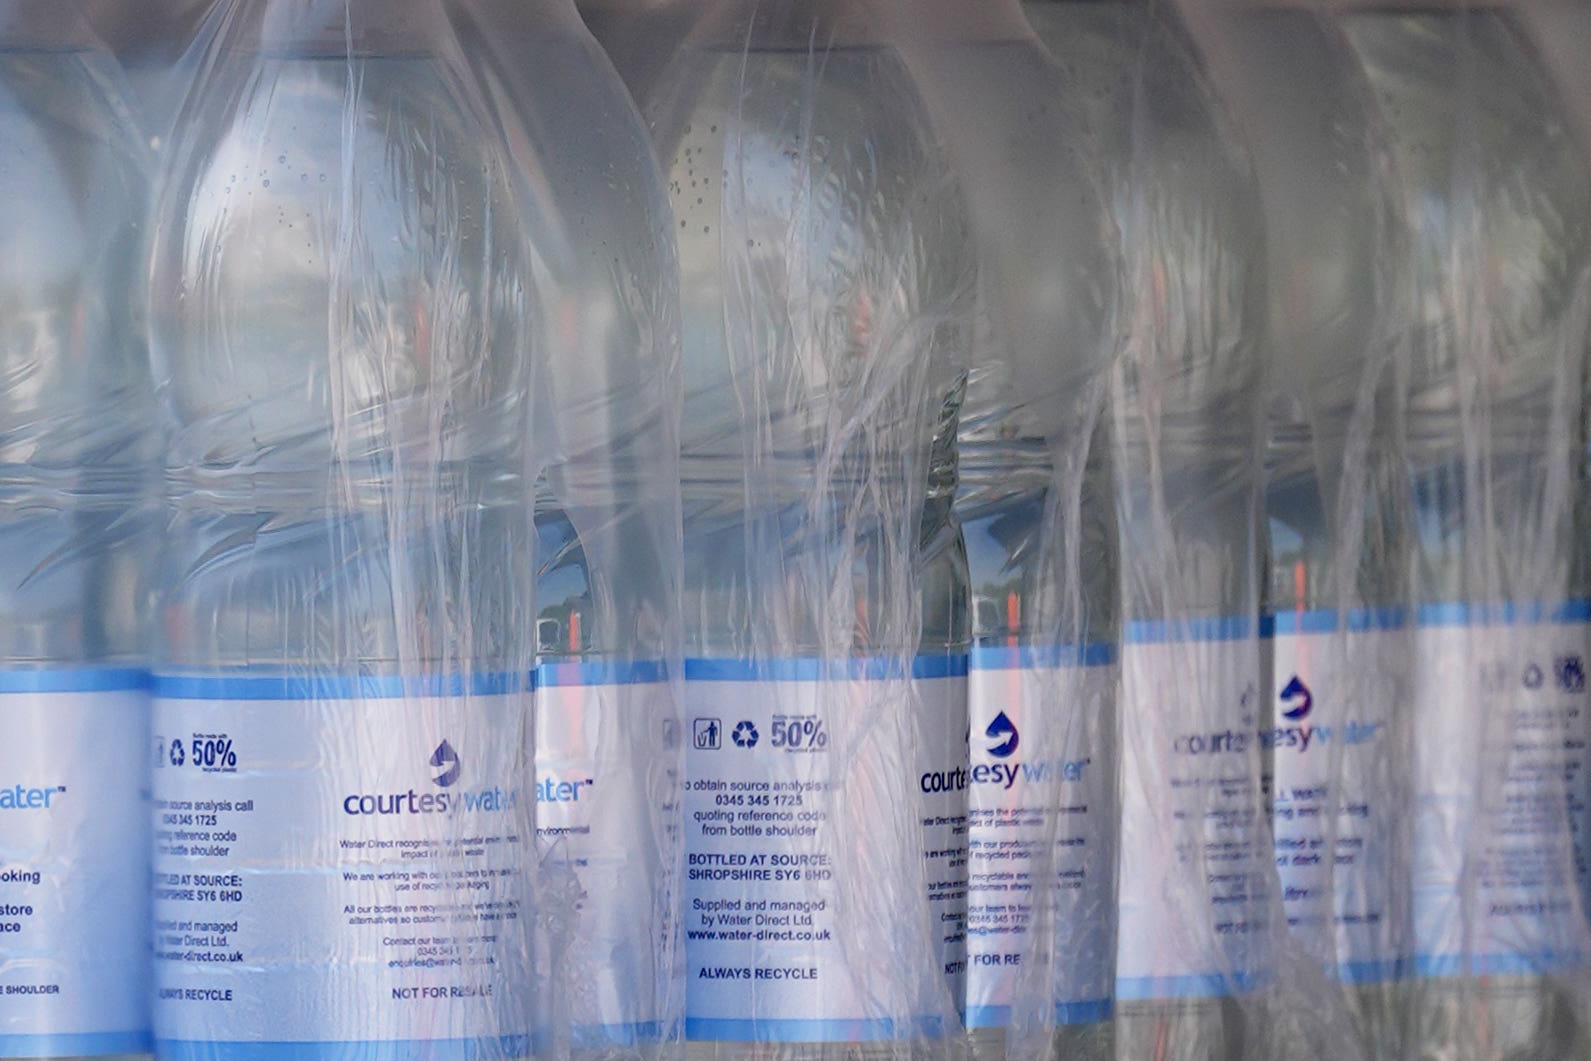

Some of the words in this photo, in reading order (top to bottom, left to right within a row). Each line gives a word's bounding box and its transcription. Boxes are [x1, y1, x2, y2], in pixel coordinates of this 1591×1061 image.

[771, 719, 827, 748] 50%
[193, 738, 237, 767] 50%
[693, 780, 727, 792] obtain
[729, 781, 770, 792] source
[195, 800, 233, 813] analysis
[235, 800, 254, 811] call
[716, 794, 744, 806] 0345
[747, 794, 770, 806] 345
[774, 794, 803, 806] 1725
[196, 815, 218, 826] 1725
[693, 811, 735, 824] quoting
[738, 810, 794, 823] reference
[212, 830, 237, 842] code
[702, 824, 728, 836] from
[730, 824, 763, 837] bottle
[766, 825, 817, 837] shoulder
[191, 845, 230, 856] shoulder
[688, 853, 747, 866] BOTTLED
[749, 854, 768, 866] AT
[194, 875, 243, 887] SOURCE:
[688, 868, 772, 881] SHROPSHIRE
[775, 869, 801, 881] SY6
[197, 890, 217, 902] SY6
[220, 890, 243, 902] 6HD
[693, 898, 742, 912] Supplied
[745, 900, 767, 912] and
[770, 900, 826, 915] managed
[702, 913, 715, 928] by
[717, 914, 753, 926] Water
[756, 914, 790, 926] Direct
[194, 921, 238, 935] managed
[687, 929, 831, 942] www.water-direct.co.uk
[698, 968, 752, 980] ALWAYS
[755, 968, 818, 980] RECYCLE
[6, 985, 60, 995] SHOULDER
[186, 989, 233, 1001] RECYCLE
[392, 988, 419, 1000] NOT
[422, 987, 448, 999] FOR
